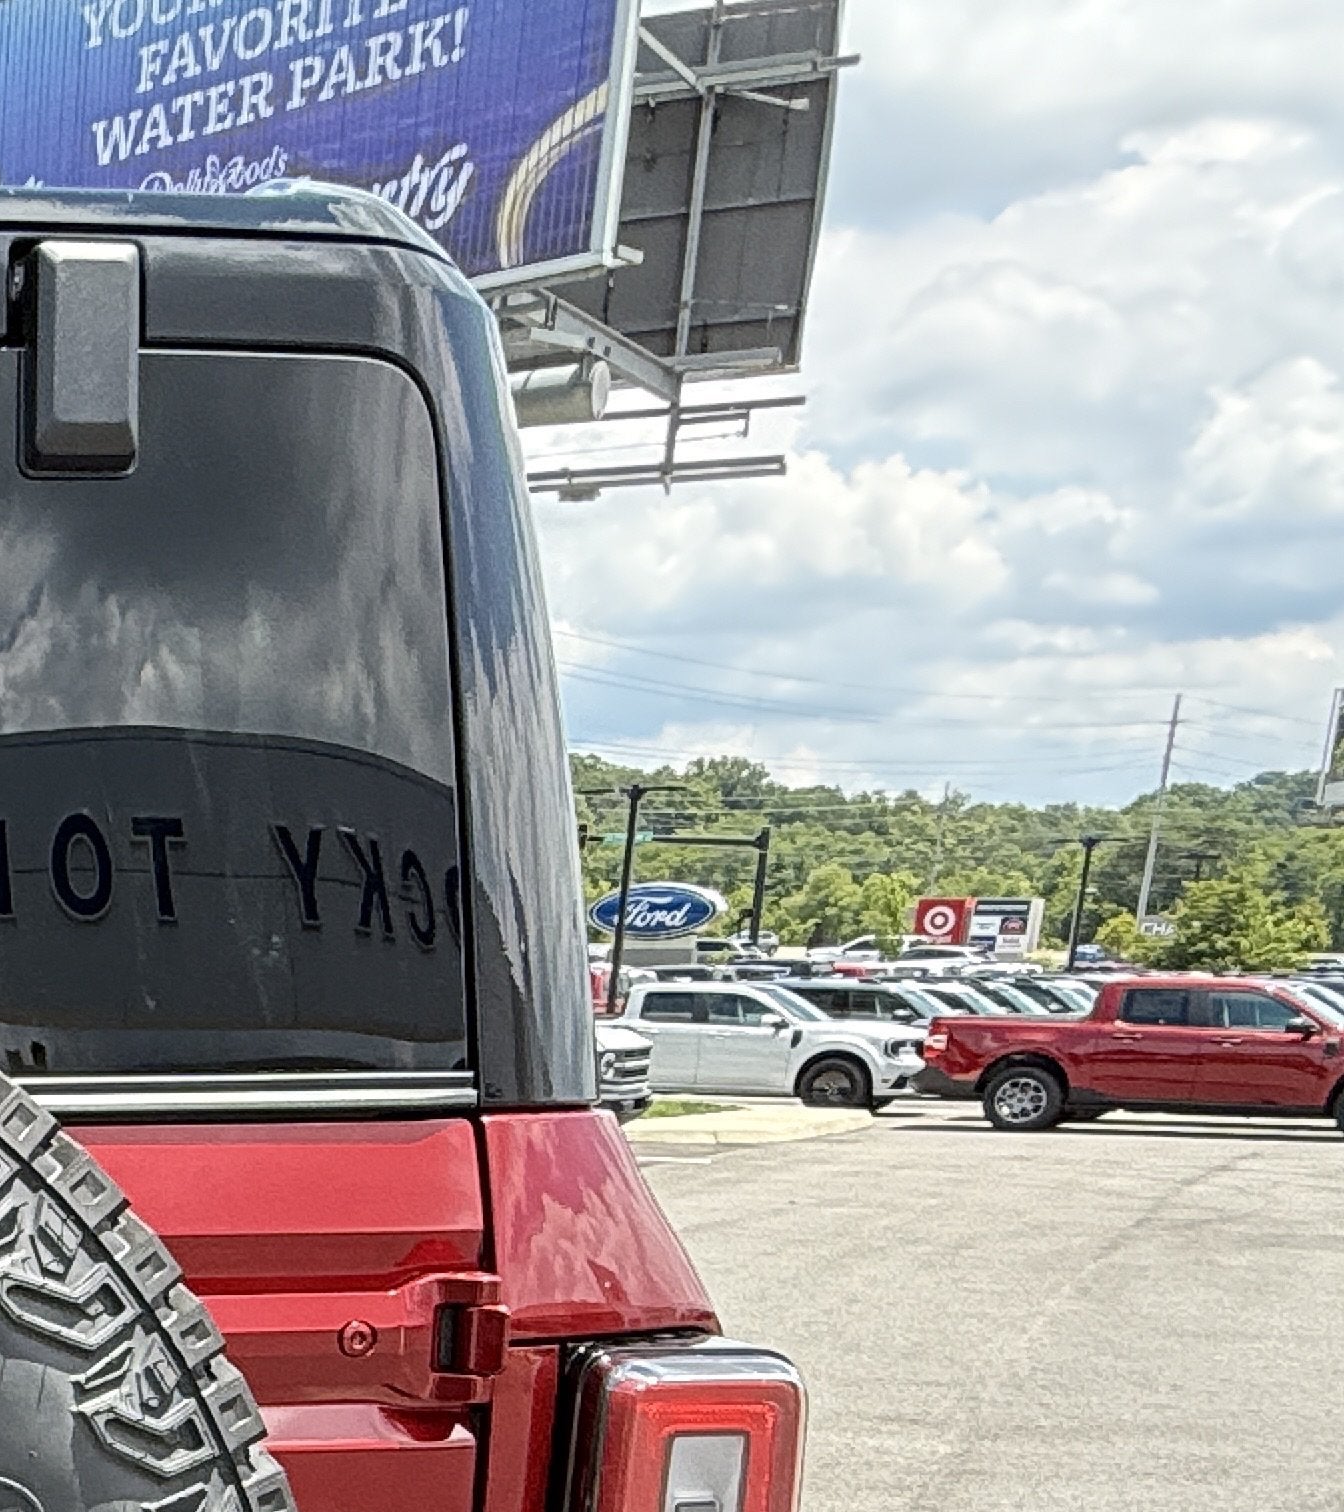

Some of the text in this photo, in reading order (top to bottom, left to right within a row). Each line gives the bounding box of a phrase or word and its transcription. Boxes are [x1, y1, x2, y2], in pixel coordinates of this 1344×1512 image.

[83, 0, 224, 49] YOU
[92, 7, 469, 166] WATER PARK!
[612, 896, 692, 928] Ford
